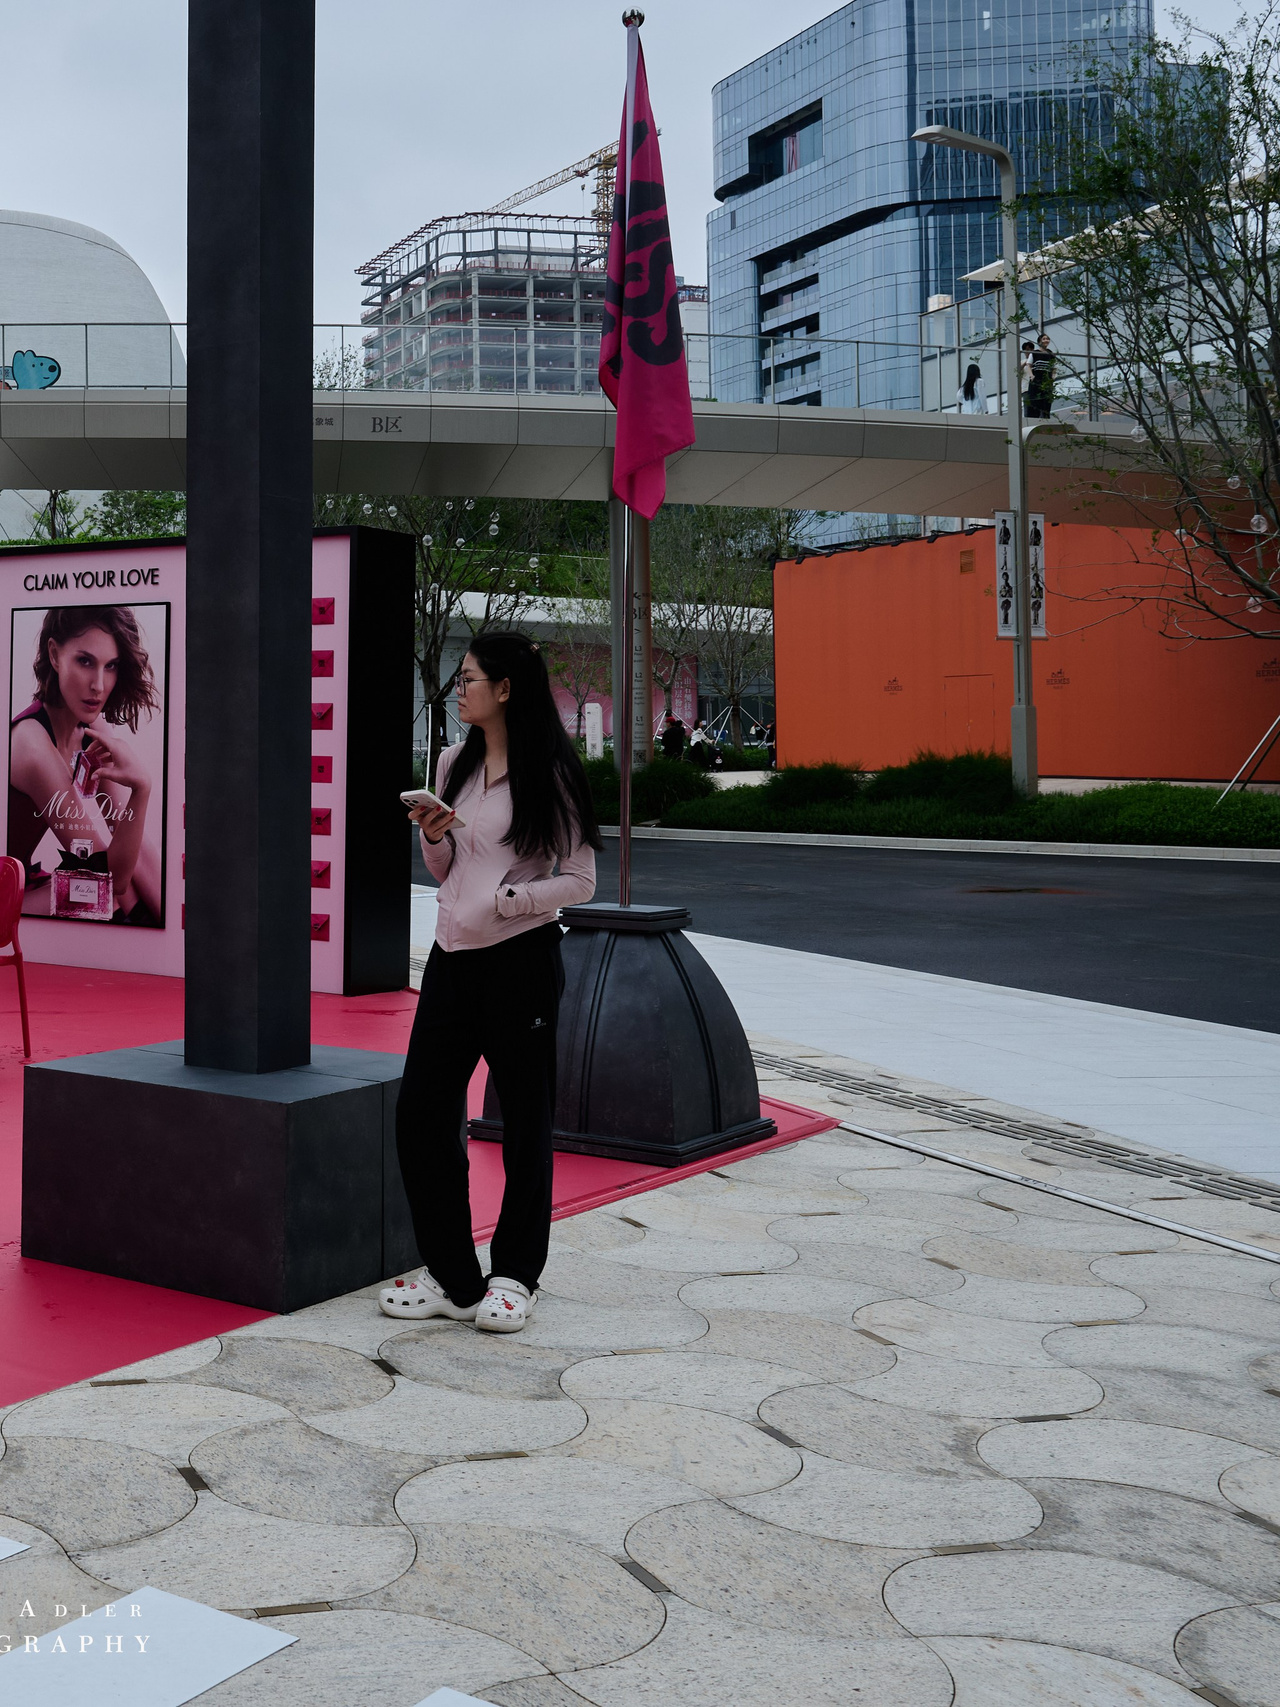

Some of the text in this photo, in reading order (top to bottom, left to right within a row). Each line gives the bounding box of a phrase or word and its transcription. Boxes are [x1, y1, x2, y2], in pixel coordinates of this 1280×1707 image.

[371, 416, 402, 433] B区
[23, 568, 159, 592] CLAIM YOUR LOVE
[33, 789, 136, 822] Miss Dior
